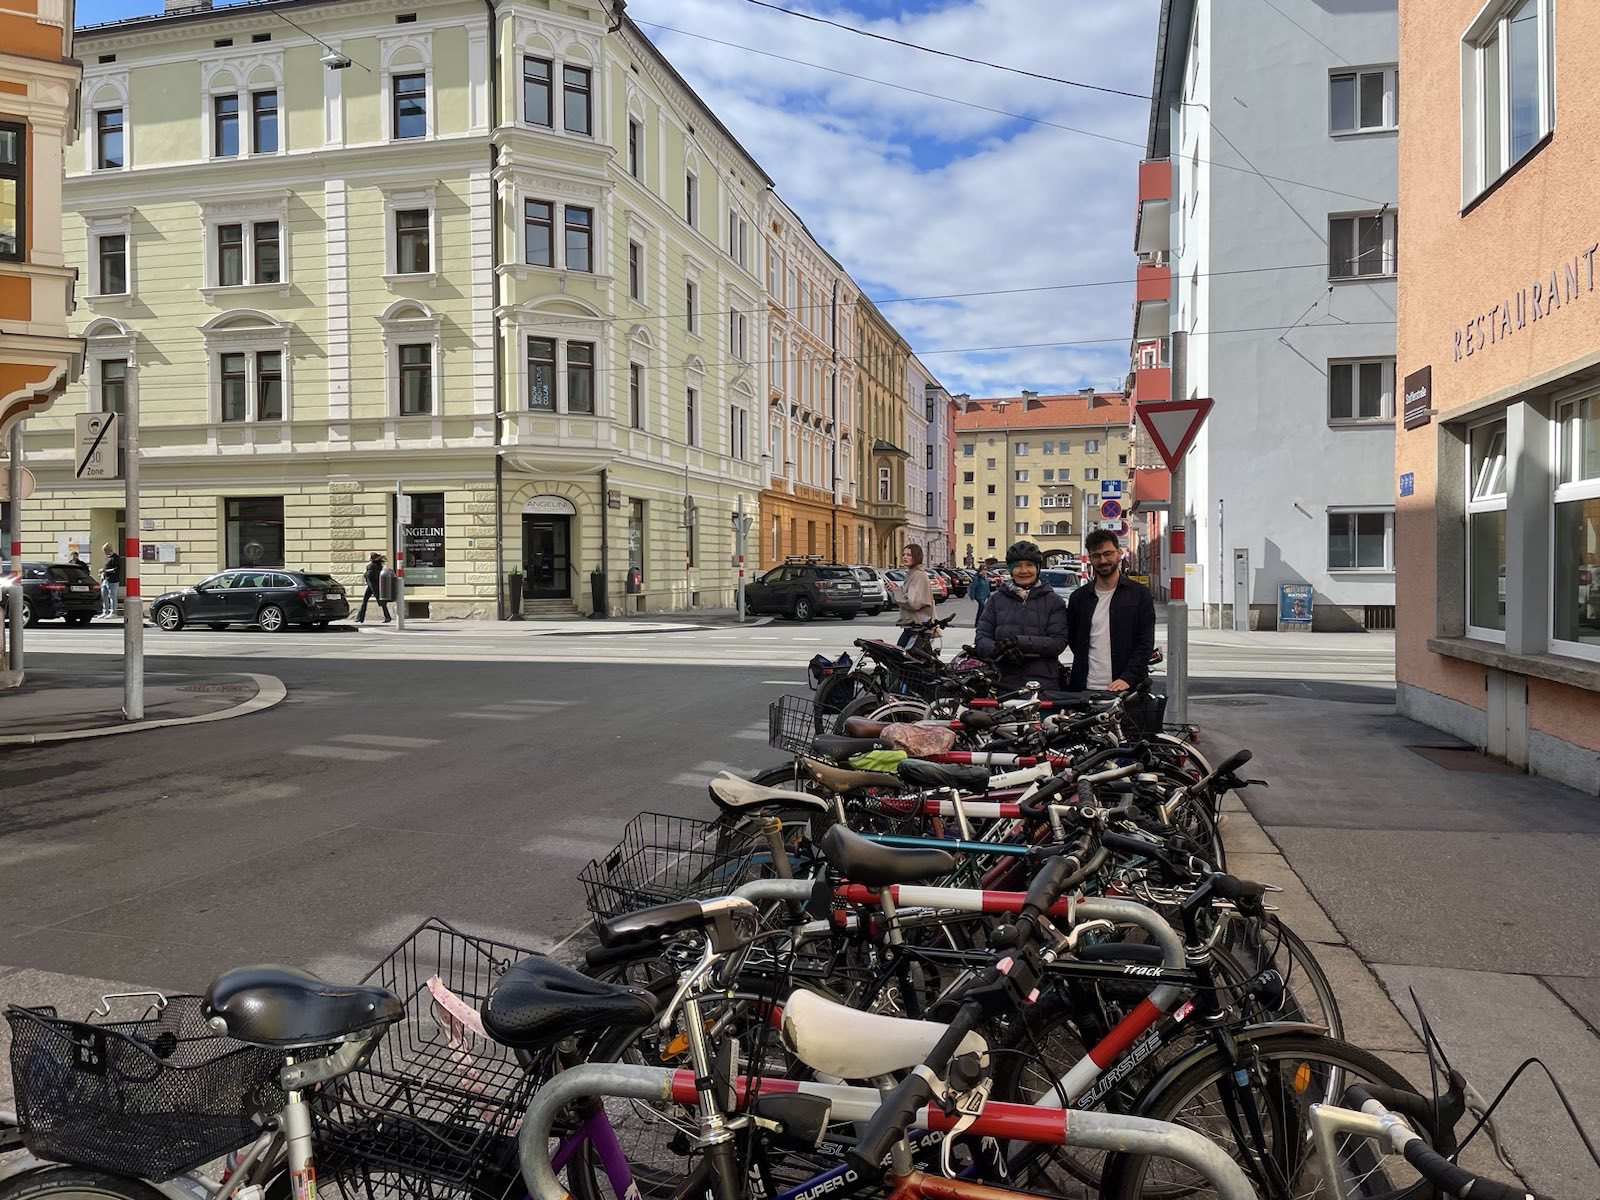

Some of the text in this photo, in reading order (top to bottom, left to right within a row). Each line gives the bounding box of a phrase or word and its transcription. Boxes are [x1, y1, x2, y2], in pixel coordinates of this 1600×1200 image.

[1453, 242, 1599, 363] RESTAURANT
[90, 451, 101, 463] 30
[87, 467, 104, 476] Zone
[527, 500, 568, 508] ANGELINI
[1123, 964, 1165, 977] Track
[794, 1179, 844, 1200] SUPER
